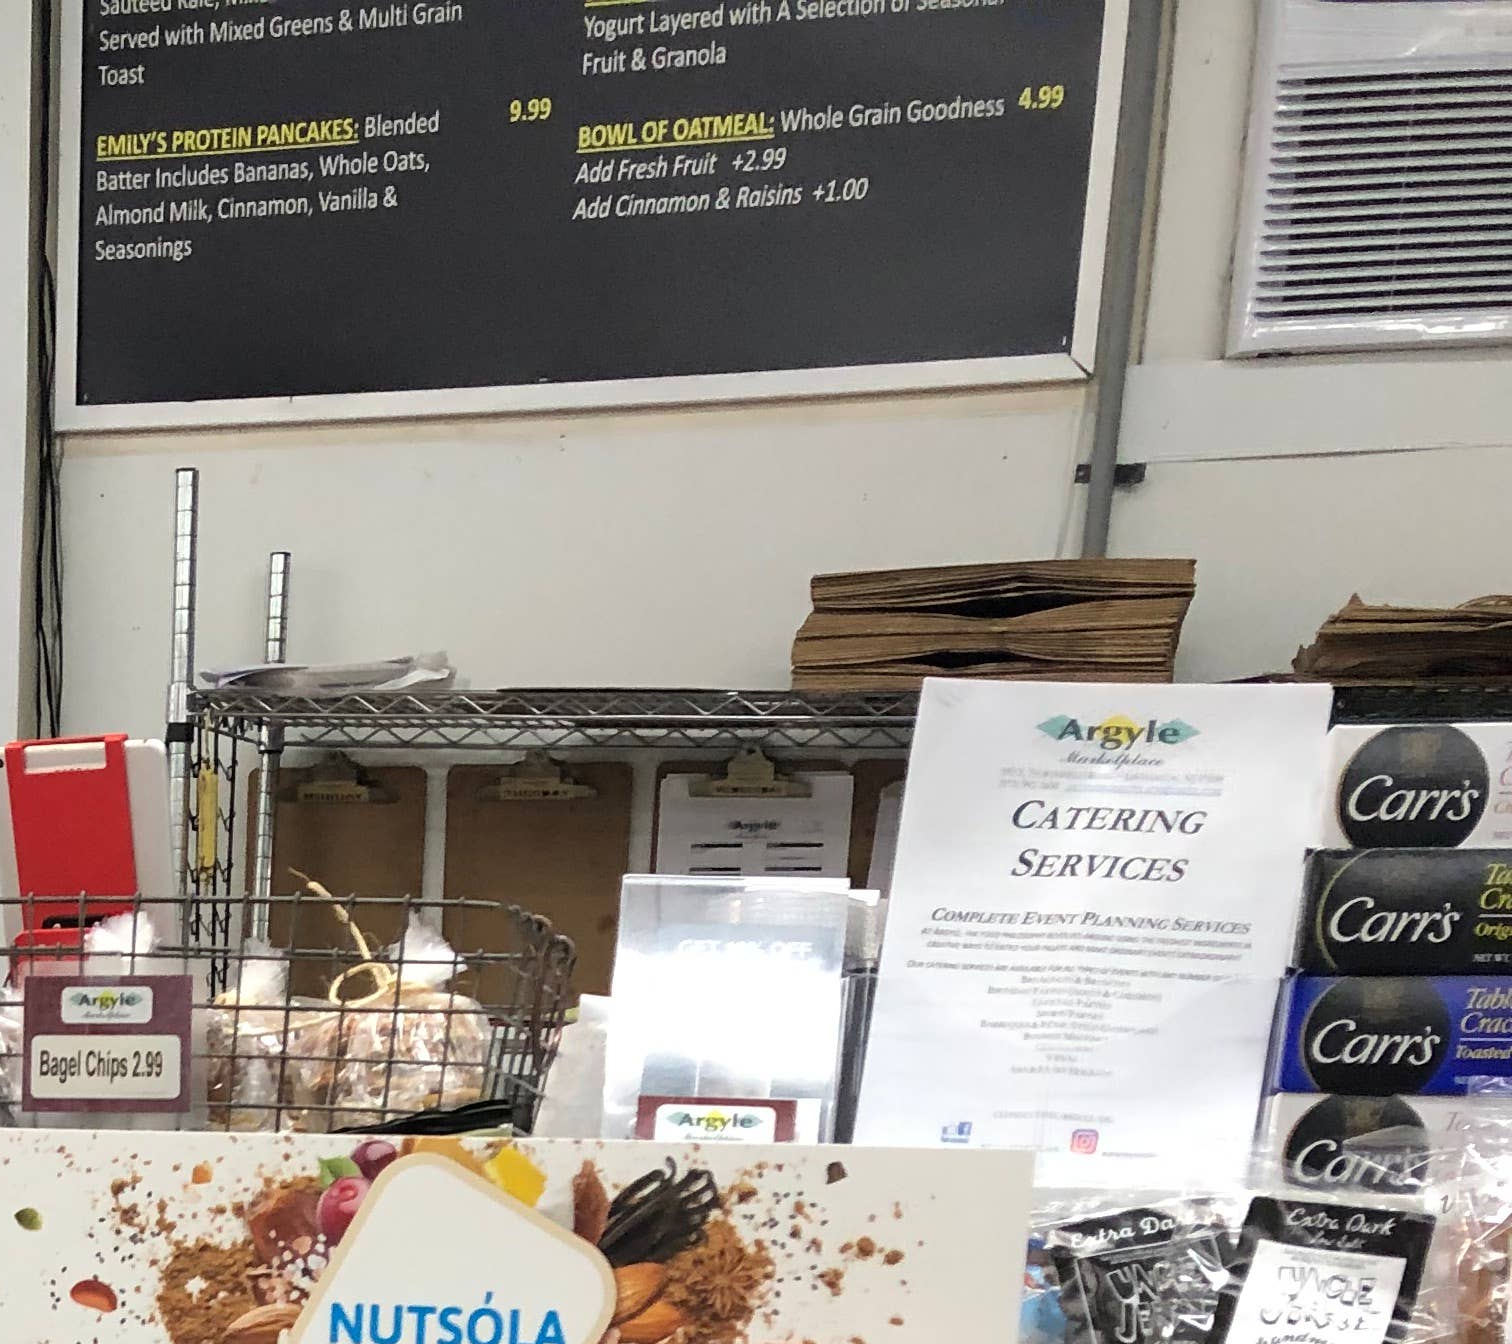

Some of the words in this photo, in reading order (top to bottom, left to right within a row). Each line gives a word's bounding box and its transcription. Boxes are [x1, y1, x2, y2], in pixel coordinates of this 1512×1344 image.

[99, 30, 159, 52] Served
[165, 27, 204, 47] with
[209, 21, 264, 43] Mixed
[270, 15, 333, 37] Greens
[339, 9, 354, 31] &
[359, 4, 408, 30] Multi
[413, 2, 462, 26] Grain
[584, 12, 644, 41] Yogurt
[649, 8, 724, 35] Layered
[729, 2, 771, 27] with
[776, 0, 791, 21] A
[796, 0, 887, 20] Selection
[99, 64, 145, 86] Toast
[582, 49, 625, 75] Fruit
[631, 49, 646, 70] &
[651, 41, 727, 70] Granola
[509, 98, 551, 122] 9.99
[578, 120, 638, 148] BOWL
[642, 118, 668, 143] OF
[673, 112, 775, 141] OATMEAL:
[782, 101, 844, 133] Whole
[849, 101, 902, 128] Grain
[907, 96, 1004, 124] Goodness
[1019, 85, 1064, 111] 4.99
[172, 126, 252, 152] PROTEIN
[257, 118, 359, 146] PANCAKES:
[364, 111, 439, 138] Blended
[96, 170, 150, 192] Batter
[156, 165, 228, 188] Includes
[234, 161, 314, 184] Bananas,
[319, 154, 378, 177] Whole
[384, 151, 430, 172] Oats,
[575, 159, 614, 184] Add
[619, 155, 667, 180] Fresh
[673, 150, 717, 177] Fruit
[732, 147, 787, 174] +2.99
[96, 204, 164, 226] Almond
[170, 201, 212, 224] Milk,
[218, 196, 313, 220] Cinnamon,
[319, 188, 378, 213] Vanilla
[383, 185, 398, 208] &
[573, 196, 612, 219] Add
[617, 188, 710, 217] Cinnamon
[715, 188, 730, 210] &
[736, 182, 802, 209] Raisins
[812, 178, 869, 203] +1.00
[96, 236, 192, 262] Seasonings
[1057, 719, 1181, 750] Argyle
[1349, 774, 1481, 822] Carr's
[1329, 896, 1461, 943] Carr's
[78, 992, 135, 1010] Argyle
[1312, 1018, 1442, 1065] Carr's
[40, 1050, 81, 1083] Bagel
[86, 1050, 128, 1084] Chips
[132, 1050, 163, 1077] 2.99
[680, 1113, 753, 1132] Argyle
[1288, 1207, 1339, 1229] Extra
[1346, 1213, 1395, 1235] Dark
